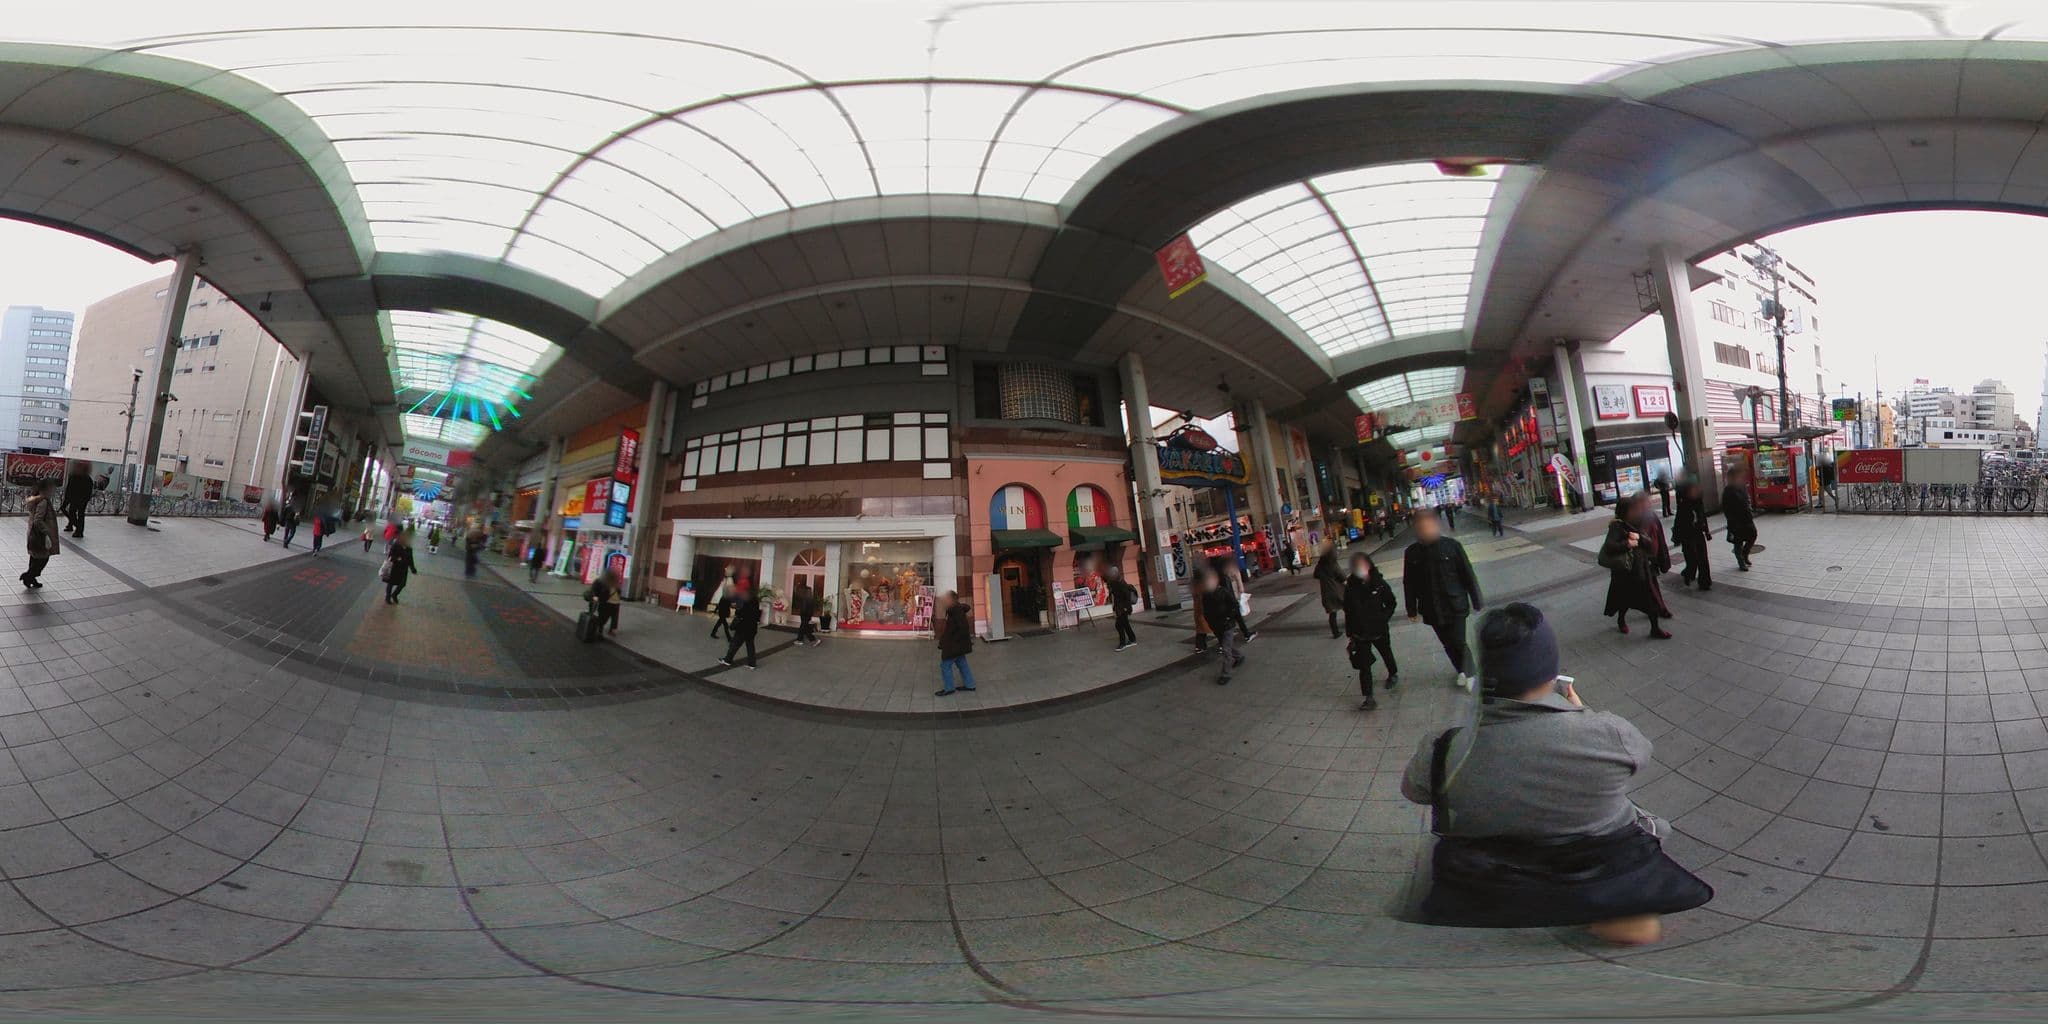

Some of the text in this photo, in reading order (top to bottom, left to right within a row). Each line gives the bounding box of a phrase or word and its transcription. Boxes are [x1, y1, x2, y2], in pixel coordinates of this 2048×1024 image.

[1642, 396, 1665, 406] 123
[408, 447, 443, 460] docomo
[999, 504, 1034, 515] WINE
